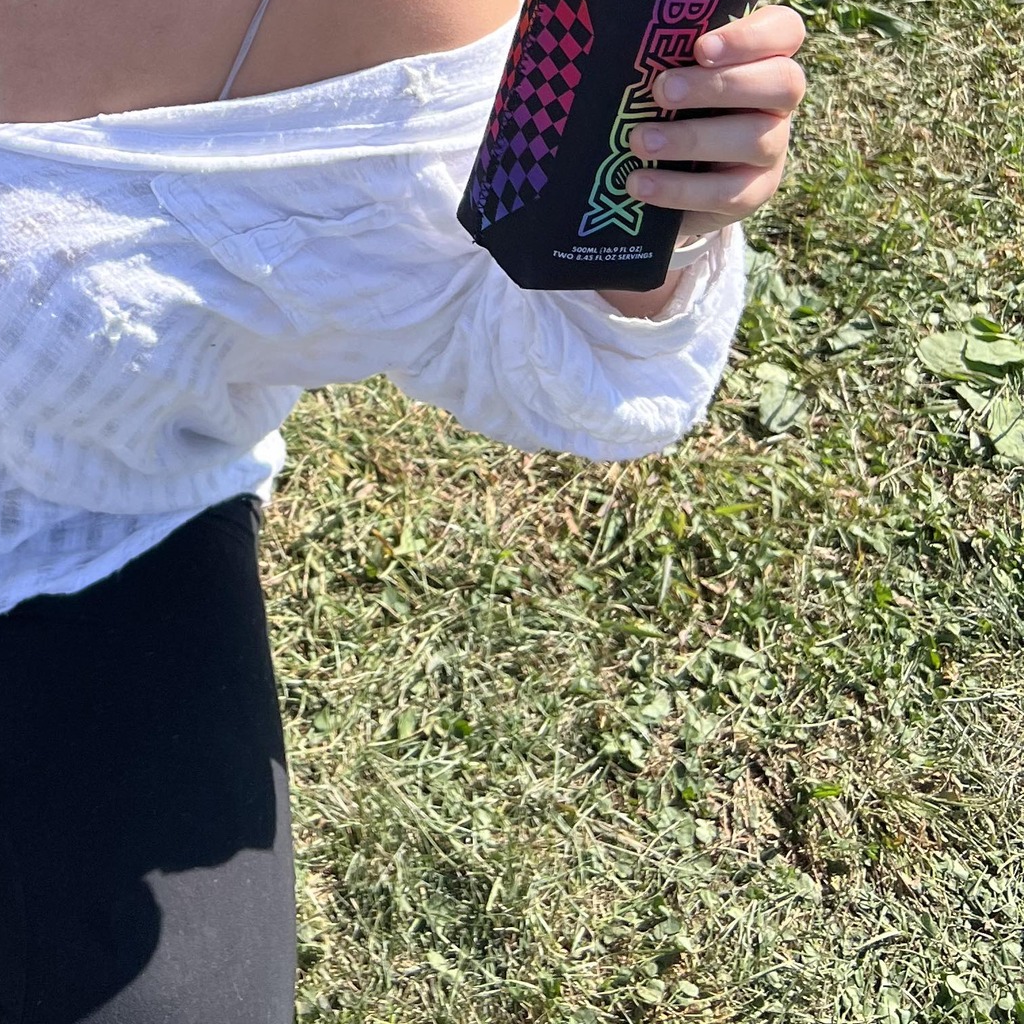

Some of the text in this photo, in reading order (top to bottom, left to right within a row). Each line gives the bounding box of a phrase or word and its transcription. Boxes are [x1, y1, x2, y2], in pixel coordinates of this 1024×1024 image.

[571, 246, 598, 254] 500ML
[628, 245, 643, 253] OZ)
[553, 250, 574, 260] TWO
[617, 252, 653, 261] SERVINGS
